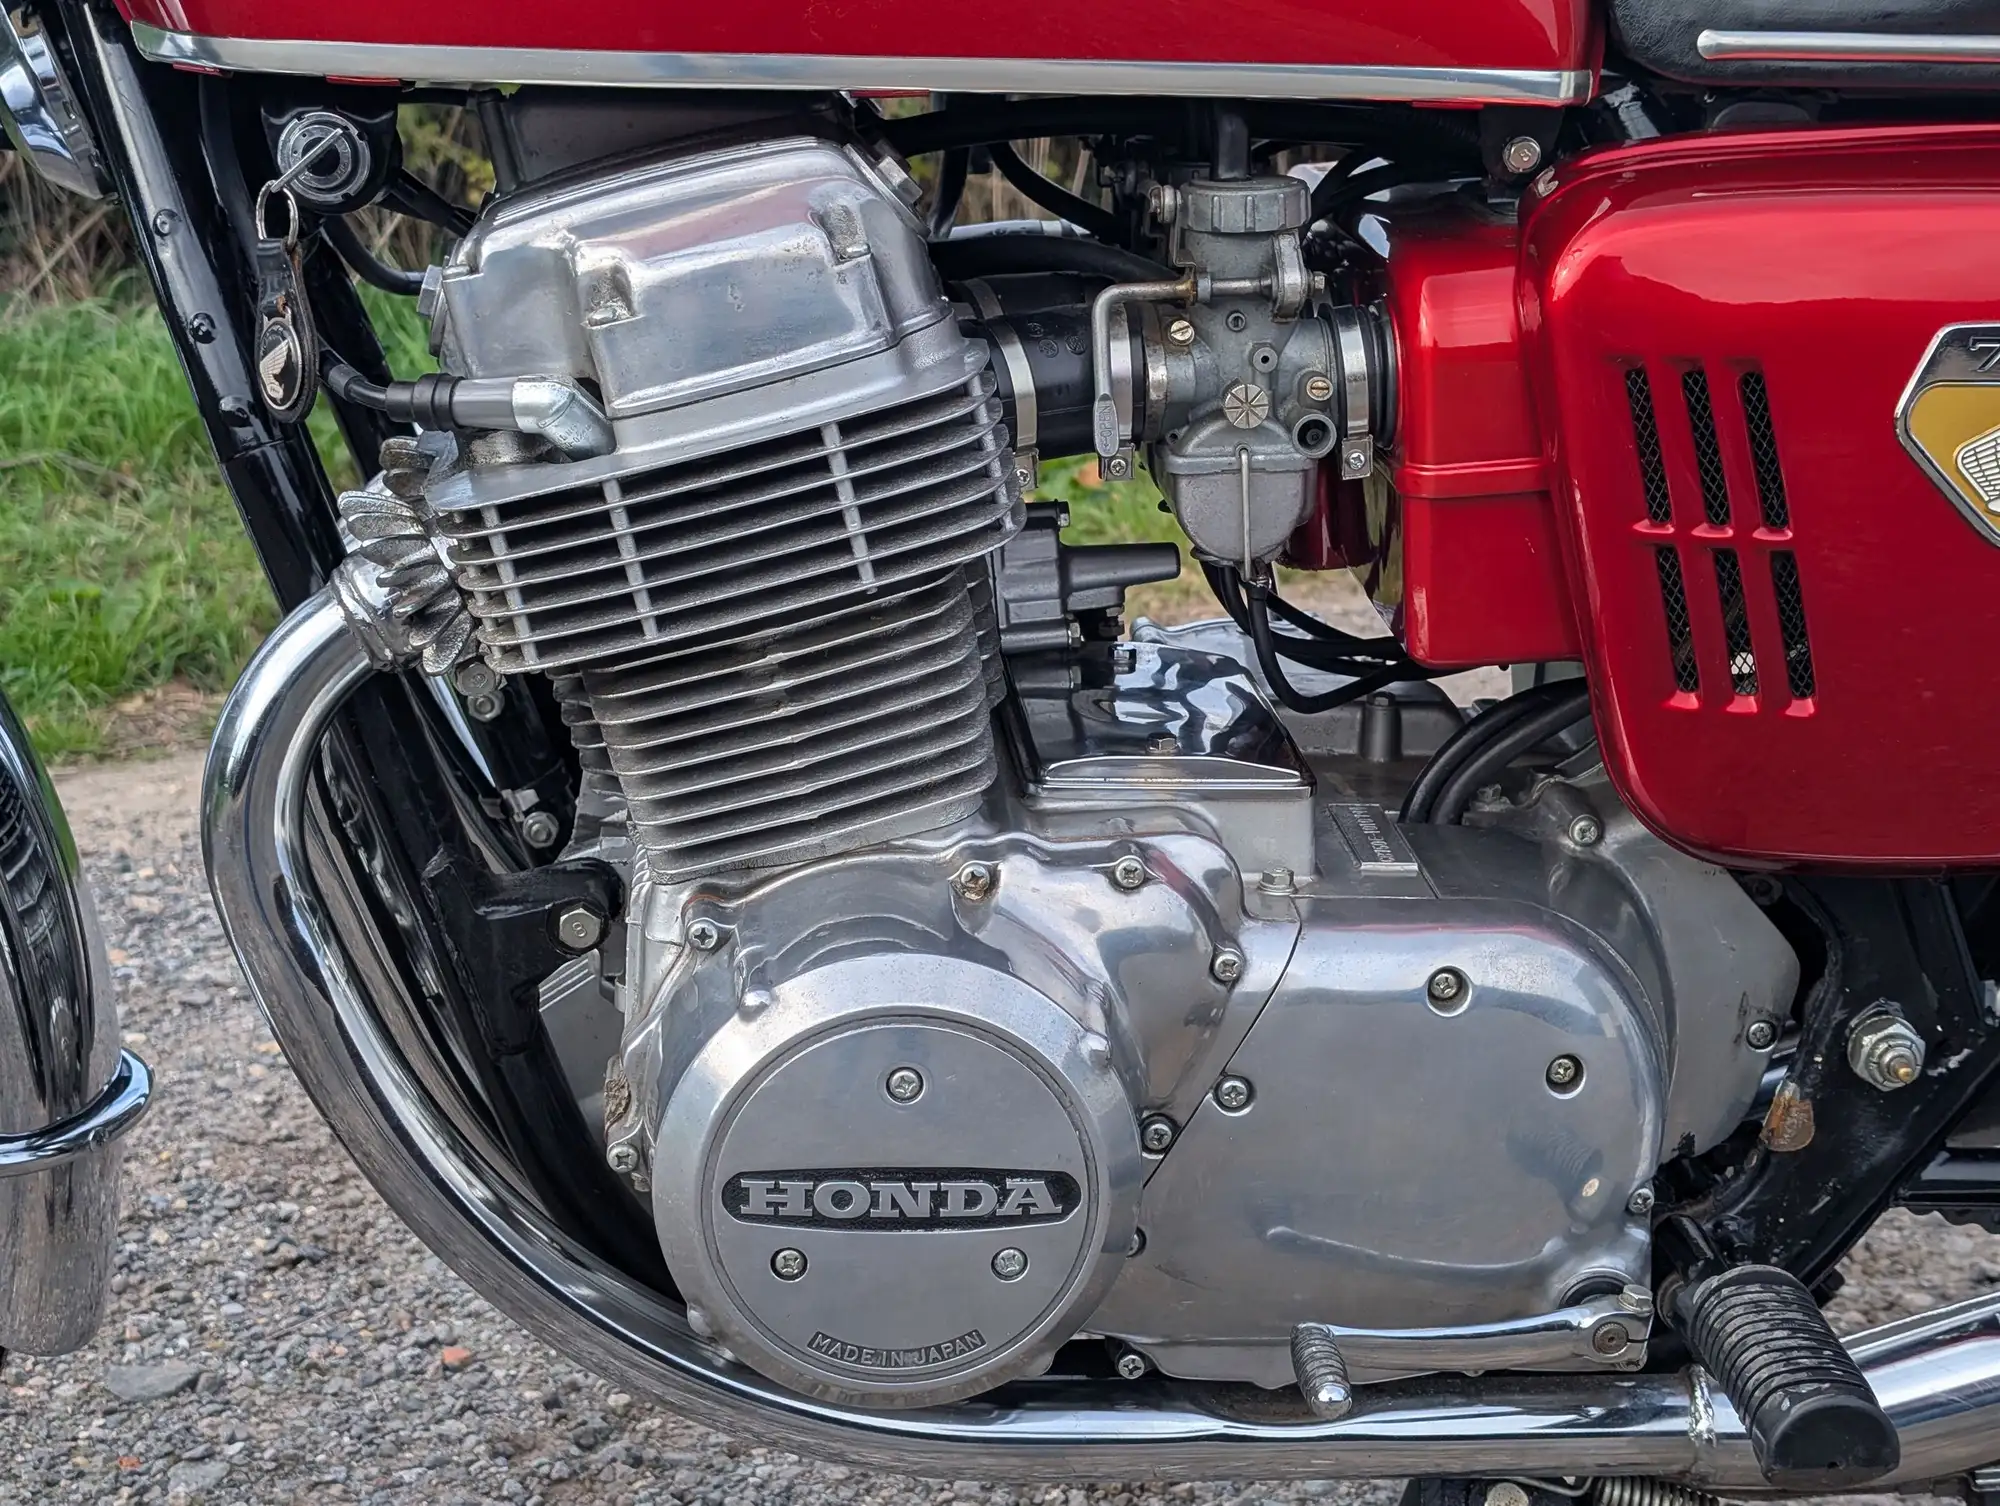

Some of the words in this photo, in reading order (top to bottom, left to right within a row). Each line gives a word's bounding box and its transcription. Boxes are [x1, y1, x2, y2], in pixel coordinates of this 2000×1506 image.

[1098, 405, 1113, 438] OPEN
[740, 1179, 1063, 1219] HONDA
[812, 1333, 875, 1366] MADE
[881, 1350, 904, 1367] IN
[914, 1331, 982, 1365] JAPAN
